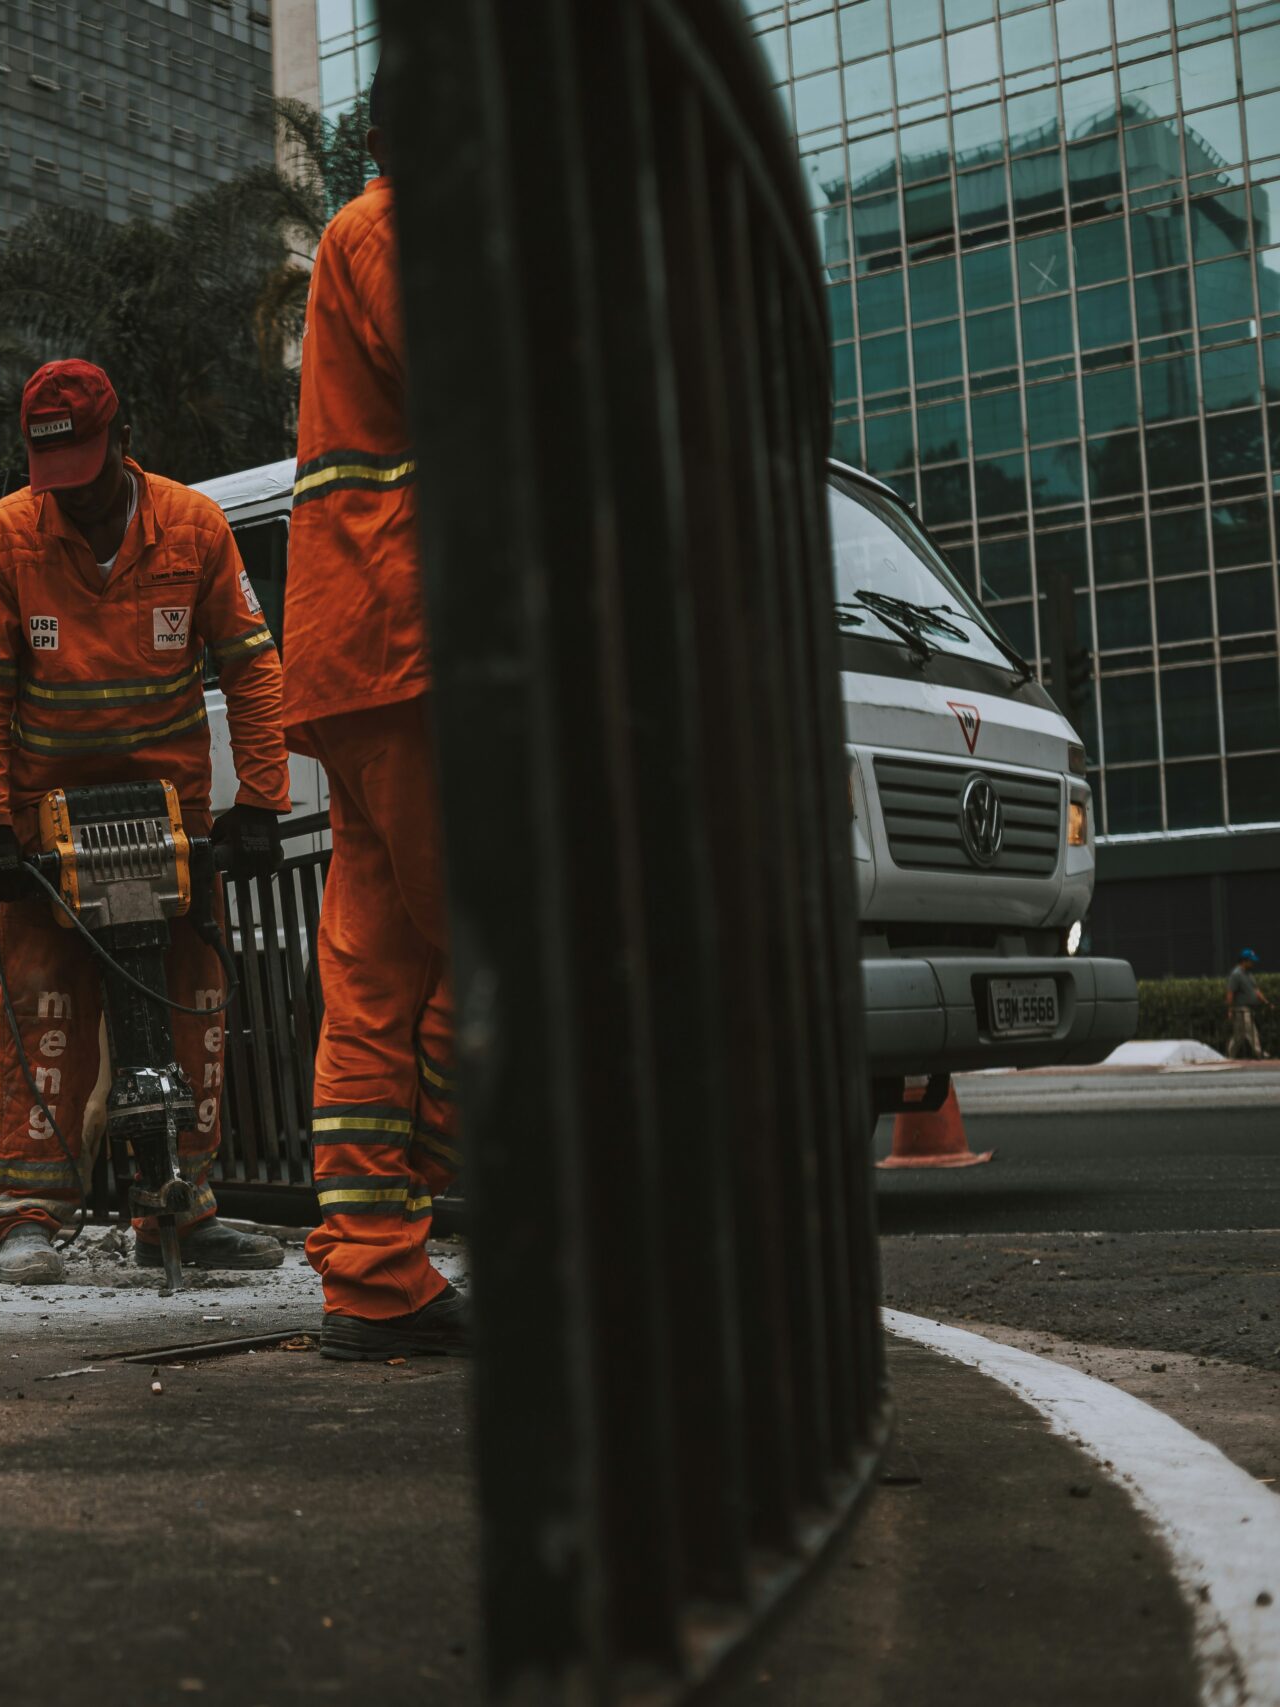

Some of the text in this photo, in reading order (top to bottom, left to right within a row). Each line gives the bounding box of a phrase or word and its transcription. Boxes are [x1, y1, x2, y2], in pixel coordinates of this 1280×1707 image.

[32, 421, 70, 434] HILFIGER
[169, 612, 179, 622] M
[30, 619, 57, 631] USE
[33, 635, 55, 648] EPI
[157, 632, 186, 646] meng
